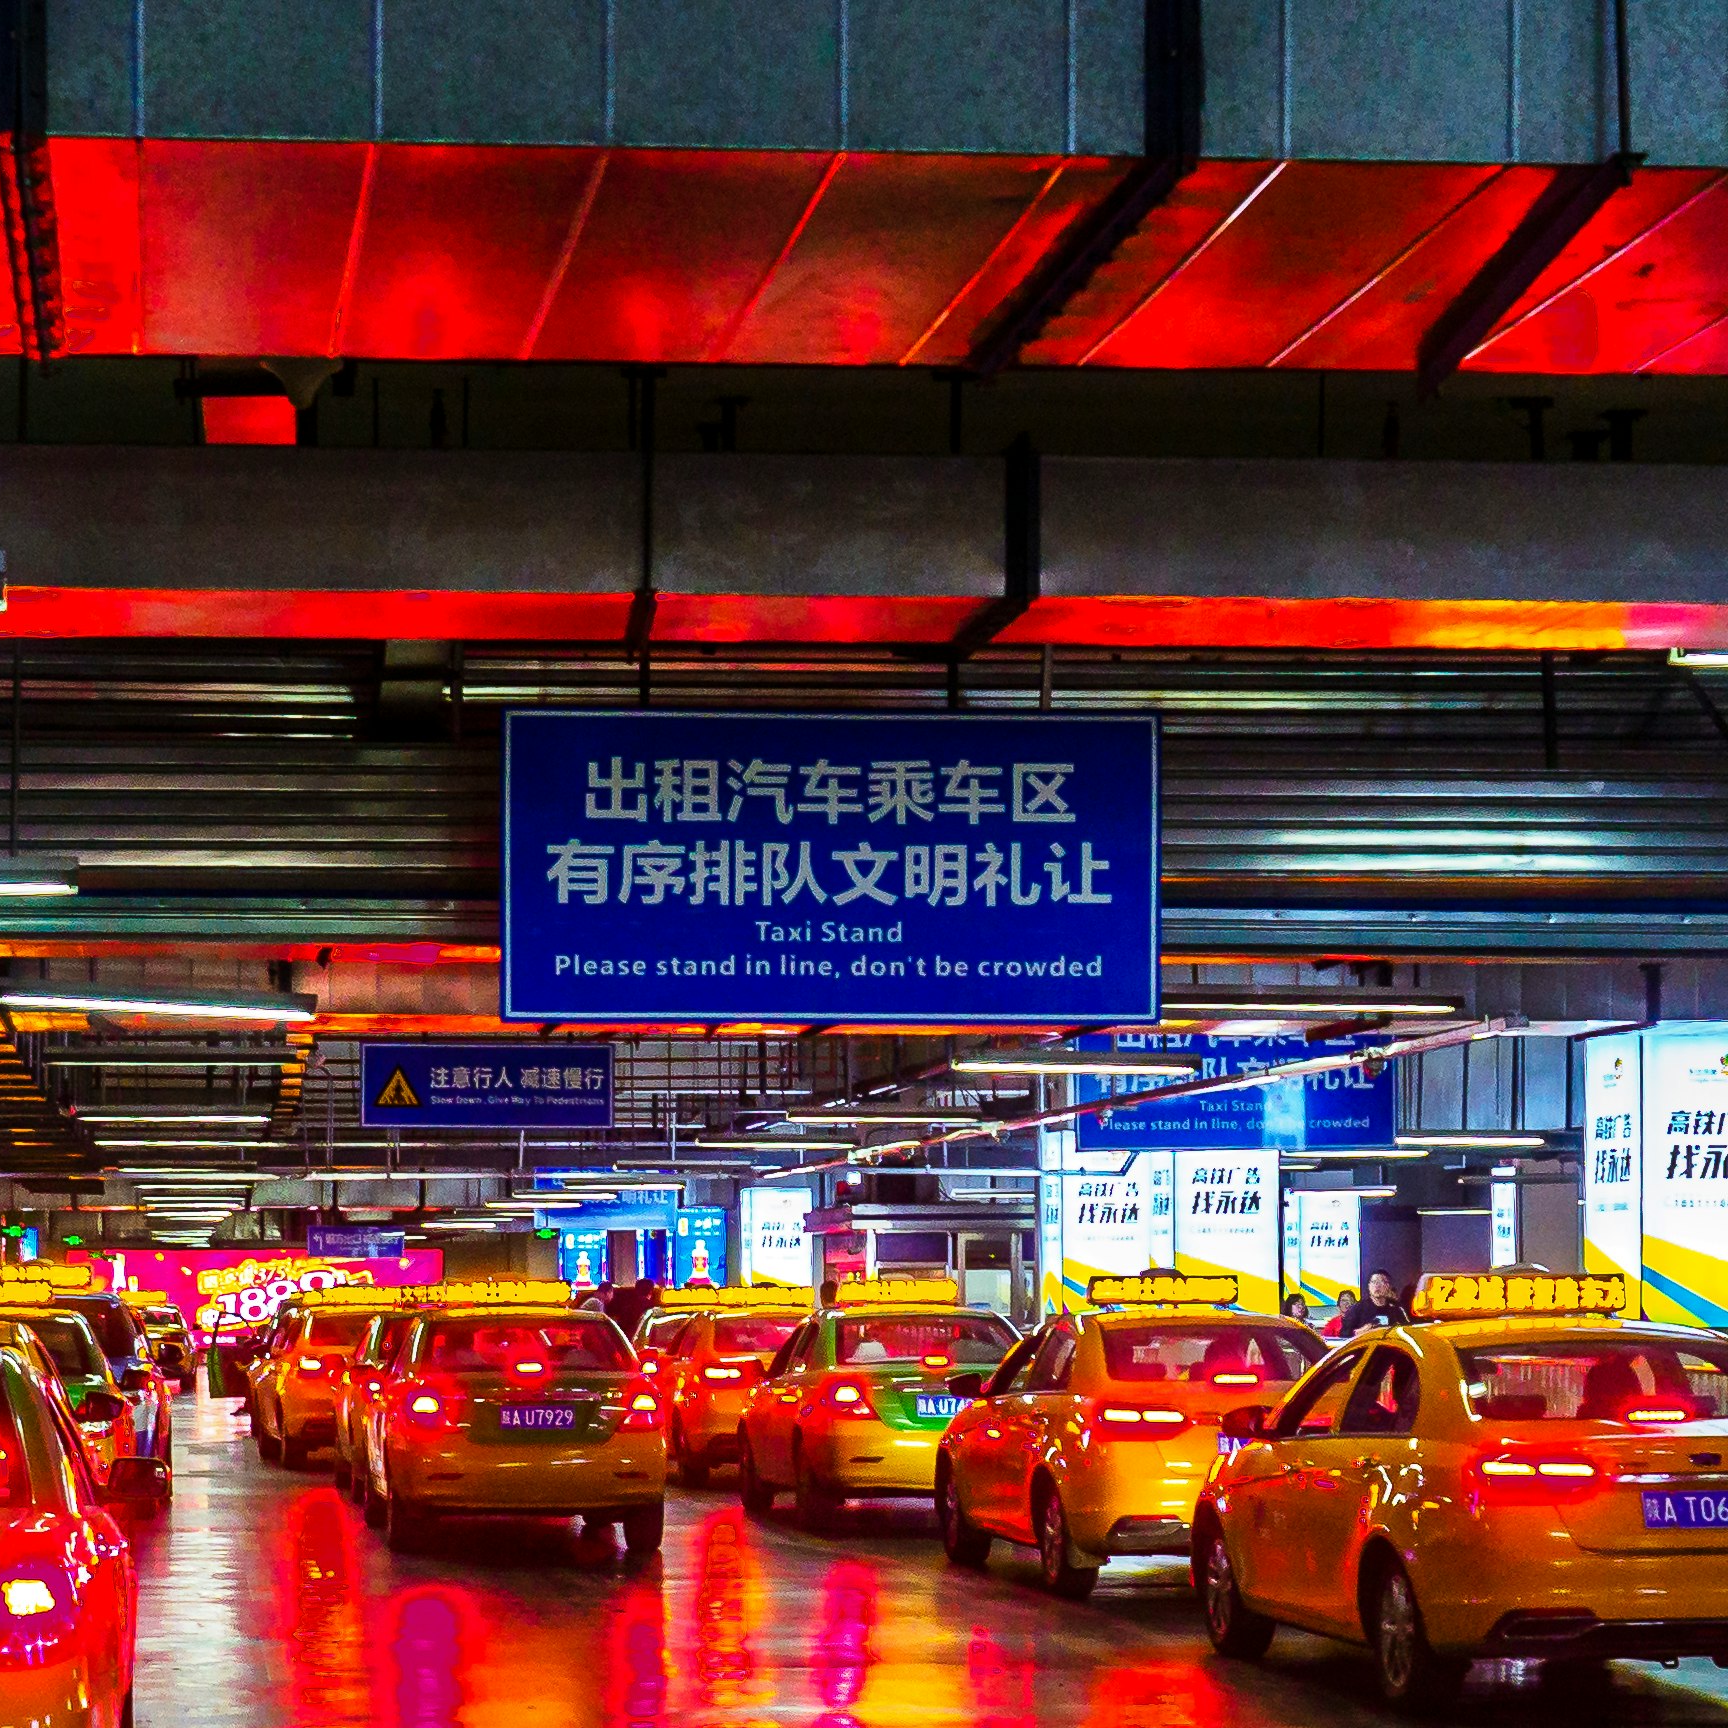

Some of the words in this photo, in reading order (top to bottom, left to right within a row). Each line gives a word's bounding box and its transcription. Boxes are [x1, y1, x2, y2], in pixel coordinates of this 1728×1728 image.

[586, 757, 1076, 824] 出租汽车乘车区
[547, 839, 1113, 906] 有序排队文明礼让
[756, 921, 812, 942] Taxi
[822, 920, 903, 942] Stand
[555, 955, 647, 977] Please
[656, 955, 736, 977] stand
[746, 955, 771, 977] in
[780, 955, 841, 980] line,
[850, 955, 927, 977] don't
[935, 955, 969, 977] be
[977, 955, 1103, 977] crowded
[430, 1066, 513, 1089] 注意行人
[521, 1066, 605, 1090] 减速慢行
[1199, 1100, 1229, 1112] Taxi
[1150, 1118, 1191, 1131] stand
[1194, 1118, 1209, 1131] in
[1308, 1116, 1371, 1130] crowded
